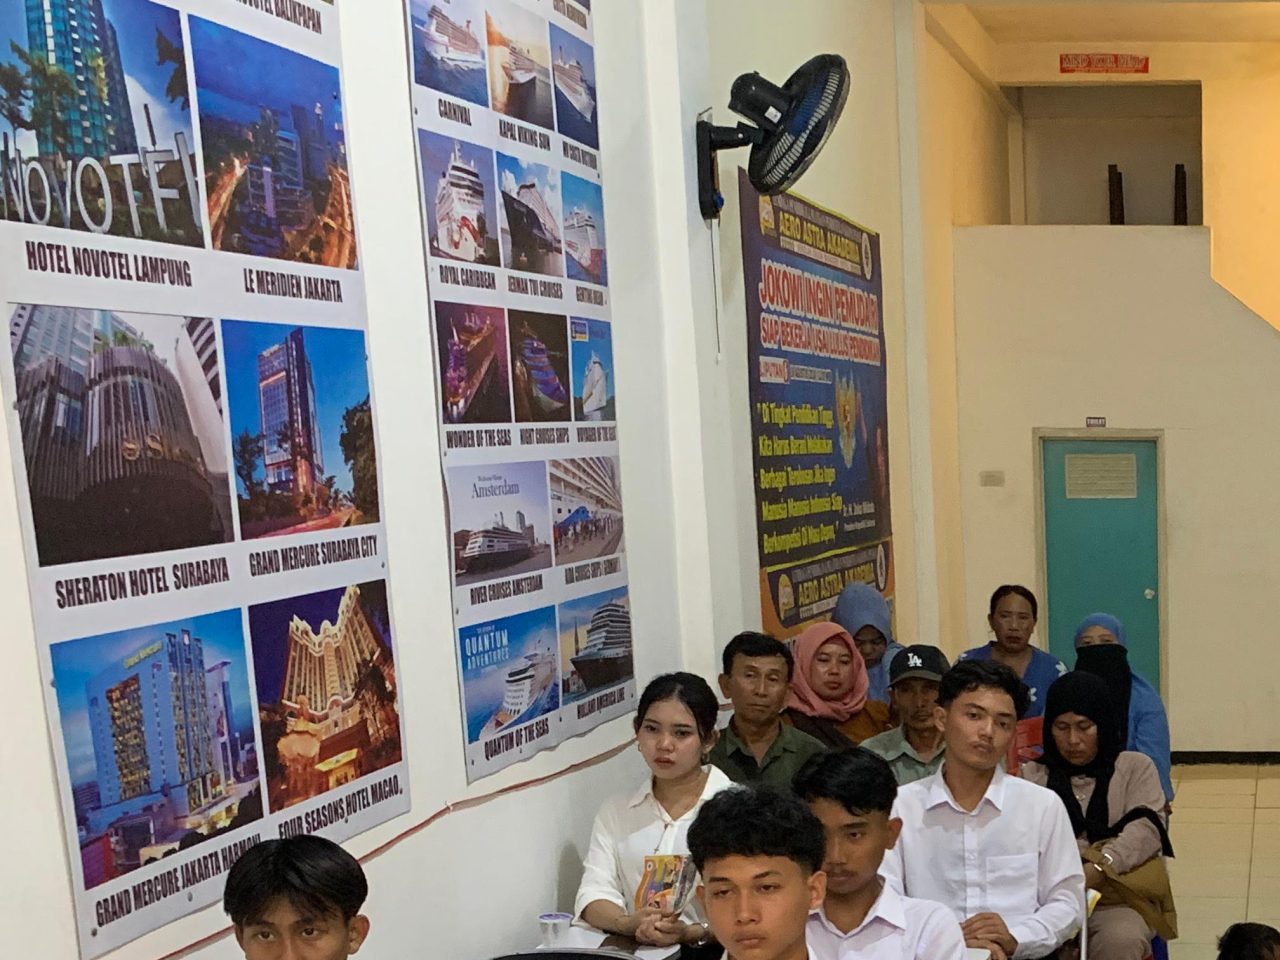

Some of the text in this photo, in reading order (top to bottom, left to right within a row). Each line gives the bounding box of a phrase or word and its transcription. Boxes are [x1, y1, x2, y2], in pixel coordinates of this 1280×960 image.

[438, 98, 472, 126] CARNIVAL
[499, 119, 517, 142] KAPAL
[779, 211, 801, 241] AERO
[803, 220, 826, 252] ASTRA
[26, 240, 192, 287] HOTEL NOVOTEL LAMPUNG
[440, 265, 460, 285] ROYAL
[243, 268, 343, 303] LE MERIDIEN JAKARTA
[761, 316, 779, 346] SIAP
[446, 428, 512, 448] WONDER OF THE SEAS
[471, 479, 520, 499] Amsterdam
[249, 534, 378, 576] GRAND MERCURE SURABAYA CITY
[56, 557, 229, 609] SHERATON HOTEL SURABAYA
[465, 629, 509, 657] QUANTUM
[907, 652, 923, 667] LA
[484, 718, 549, 761] QUANTUM OF THE SEAS
[305, 800, 345, 836] SEASONS
[345, 793, 370, 821] HOTEL
[95, 891, 132, 928] GRAND
[132, 873, 180, 912] MERCURE
[180, 857, 222, 892] JAKARTA
